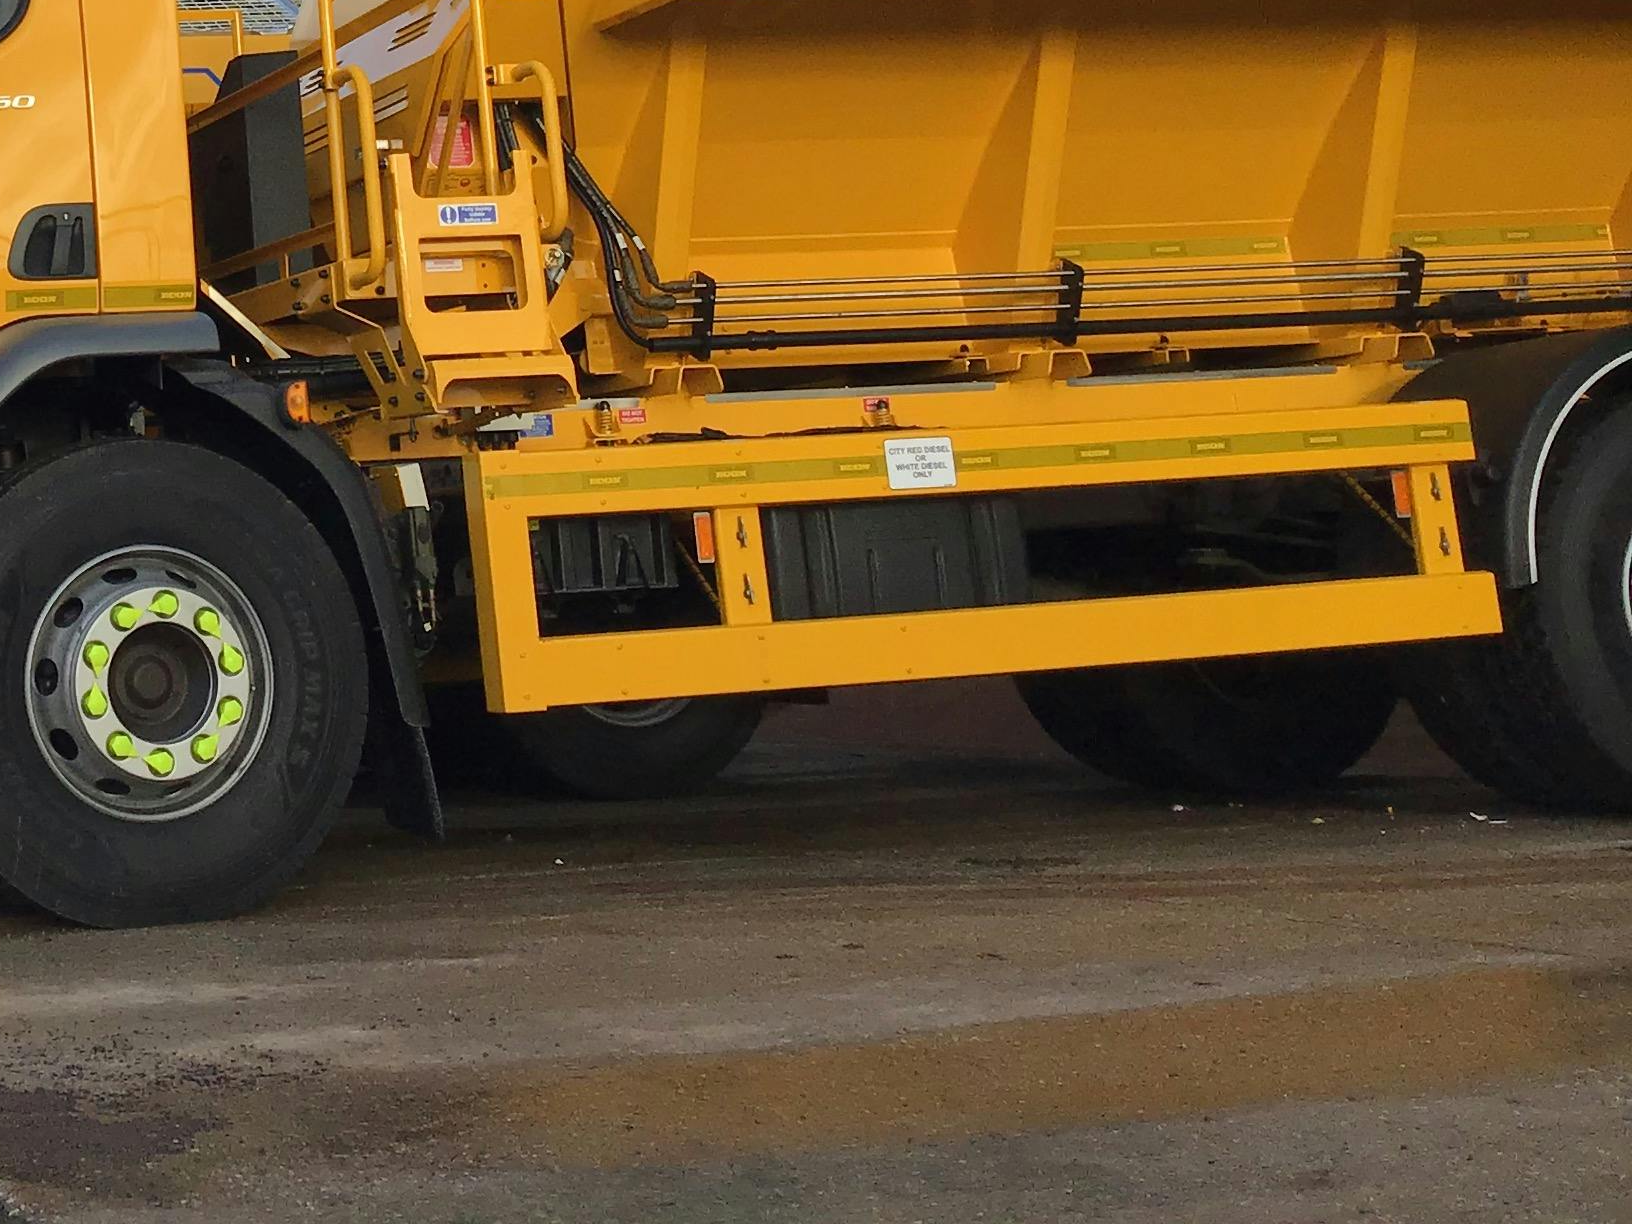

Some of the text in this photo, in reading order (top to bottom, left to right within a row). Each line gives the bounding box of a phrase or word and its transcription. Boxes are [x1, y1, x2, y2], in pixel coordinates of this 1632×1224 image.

[888, 448, 905, 456] CITY
[924, 446, 951, 454] DIESEL
[921, 462, 948, 471] DIESEL
[913, 471, 932, 479] ONLY
